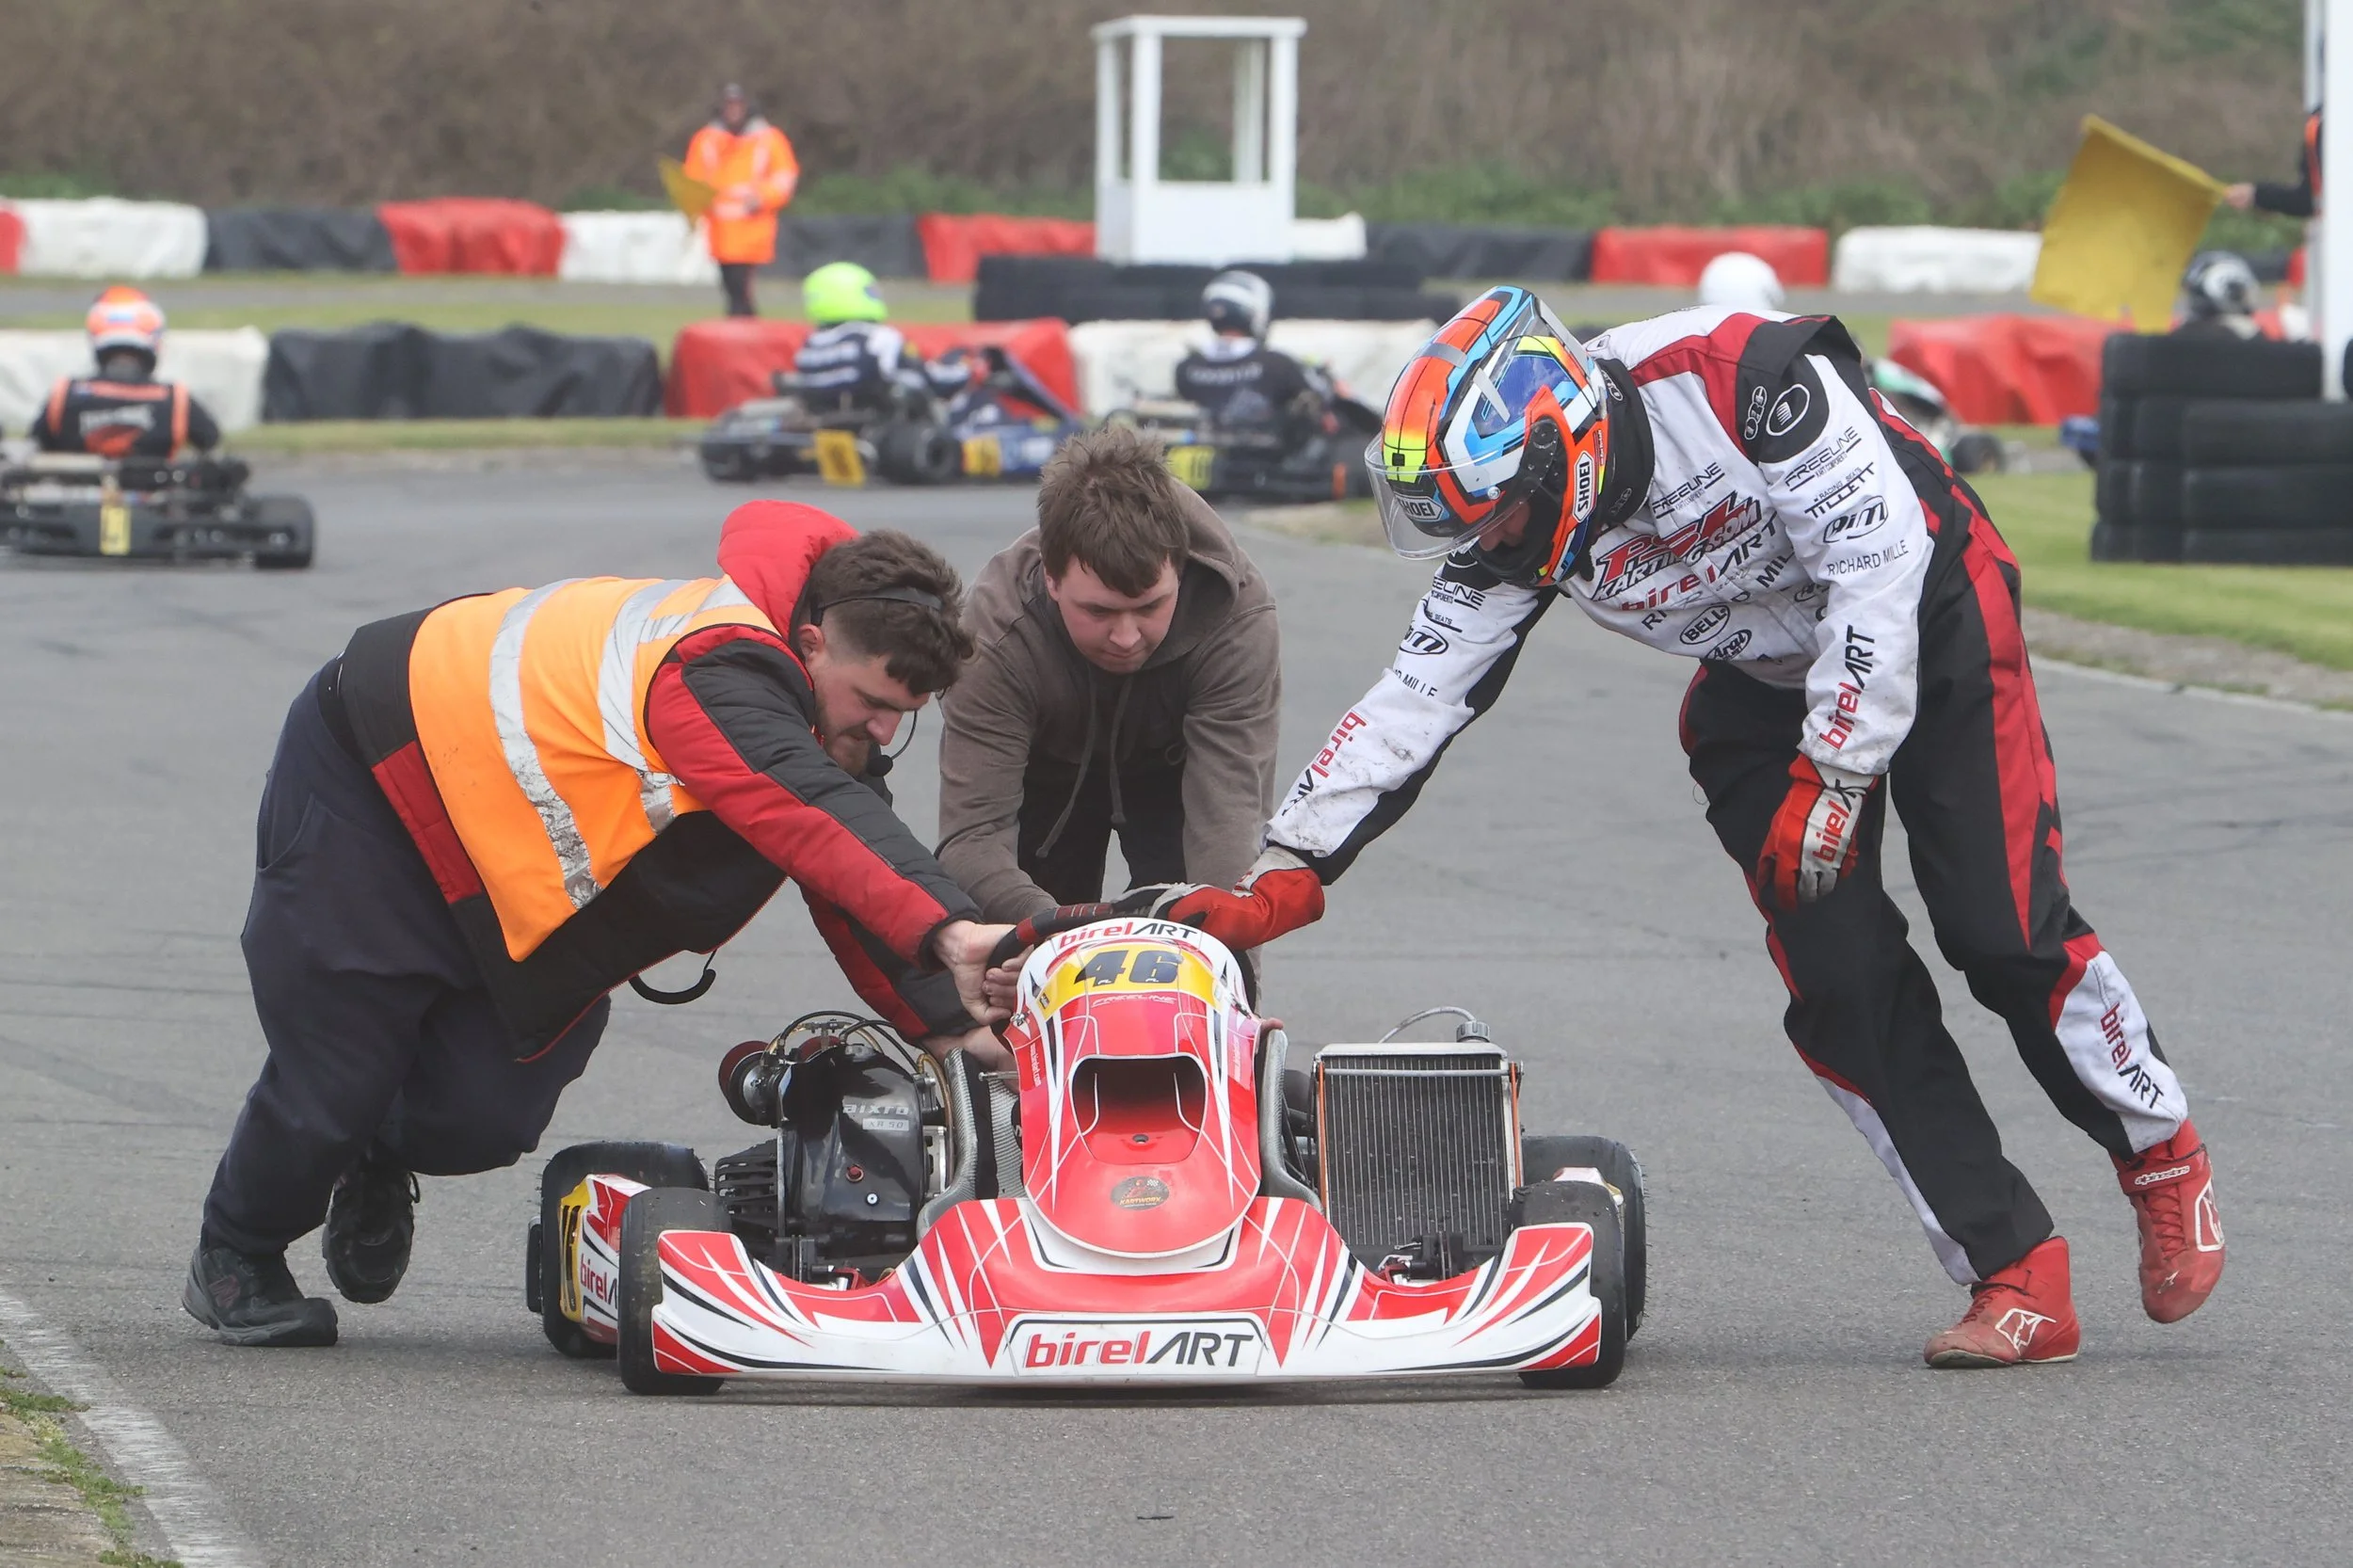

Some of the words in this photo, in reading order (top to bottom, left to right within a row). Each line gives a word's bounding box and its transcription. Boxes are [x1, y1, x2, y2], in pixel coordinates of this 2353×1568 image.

[1785, 426, 1858, 487] FREELINE
[1577, 461, 1591, 512] SHOEI
[1652, 462, 1721, 513] FREELINE
[1818, 481, 1843, 500] RACING
[1756, 551, 1796, 588] MIL
[1827, 552, 1881, 576] RICHARD
[1881, 539, 1910, 563] MILLE
[1684, 609, 1723, 642] BELL
[1818, 624, 1875, 750] birelART
[1059, 921, 1198, 949] birelART
[1074, 950, 1184, 987] 46
[2101, 1002, 2164, 1109] birelART
[842, 1103, 909, 1115] aixro
[580, 1253, 618, 1309] birelA
[1024, 1330, 1254, 1368] birelART
